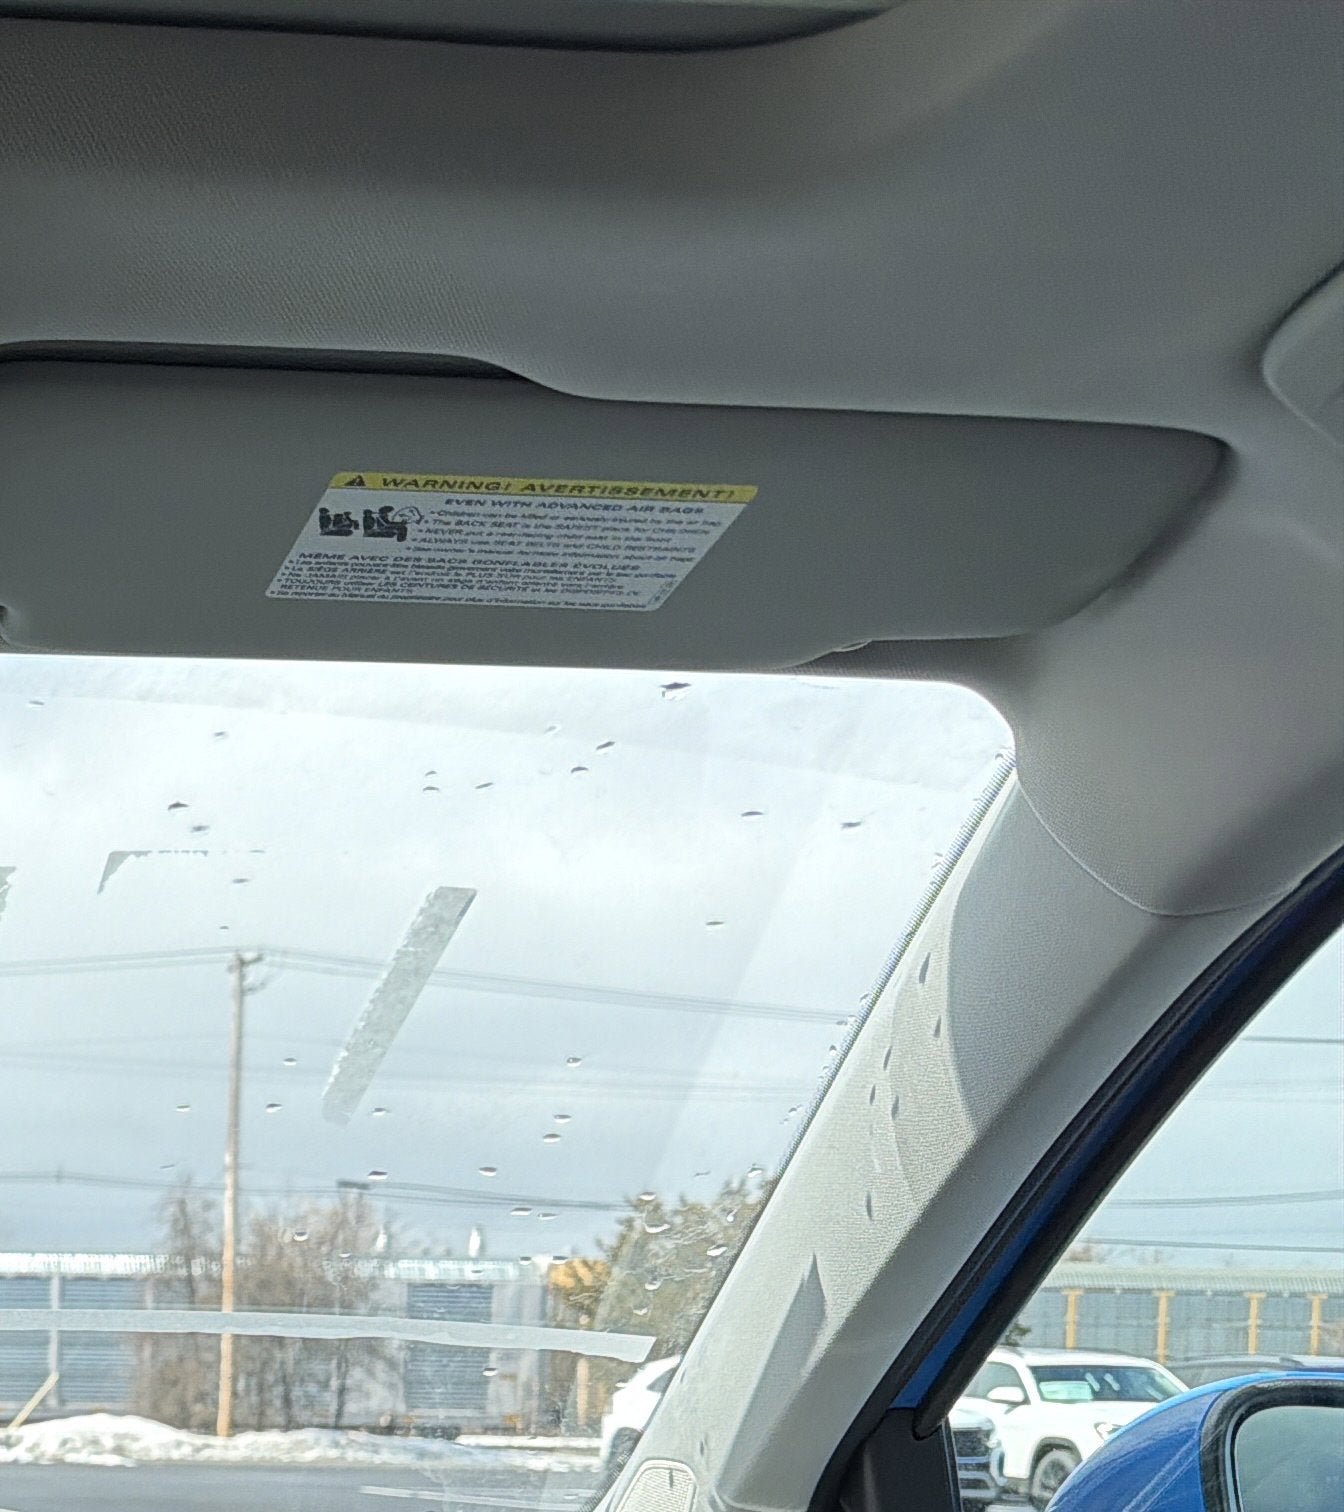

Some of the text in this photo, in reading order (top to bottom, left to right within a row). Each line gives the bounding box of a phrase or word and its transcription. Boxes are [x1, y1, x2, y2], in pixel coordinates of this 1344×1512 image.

[382, 478, 735, 499] WARNING! AVERTISSEMENT!
[444, 498, 486, 506] EVEN
[491, 500, 531, 508] WITH
[535, 501, 623, 511] ADVANCED
